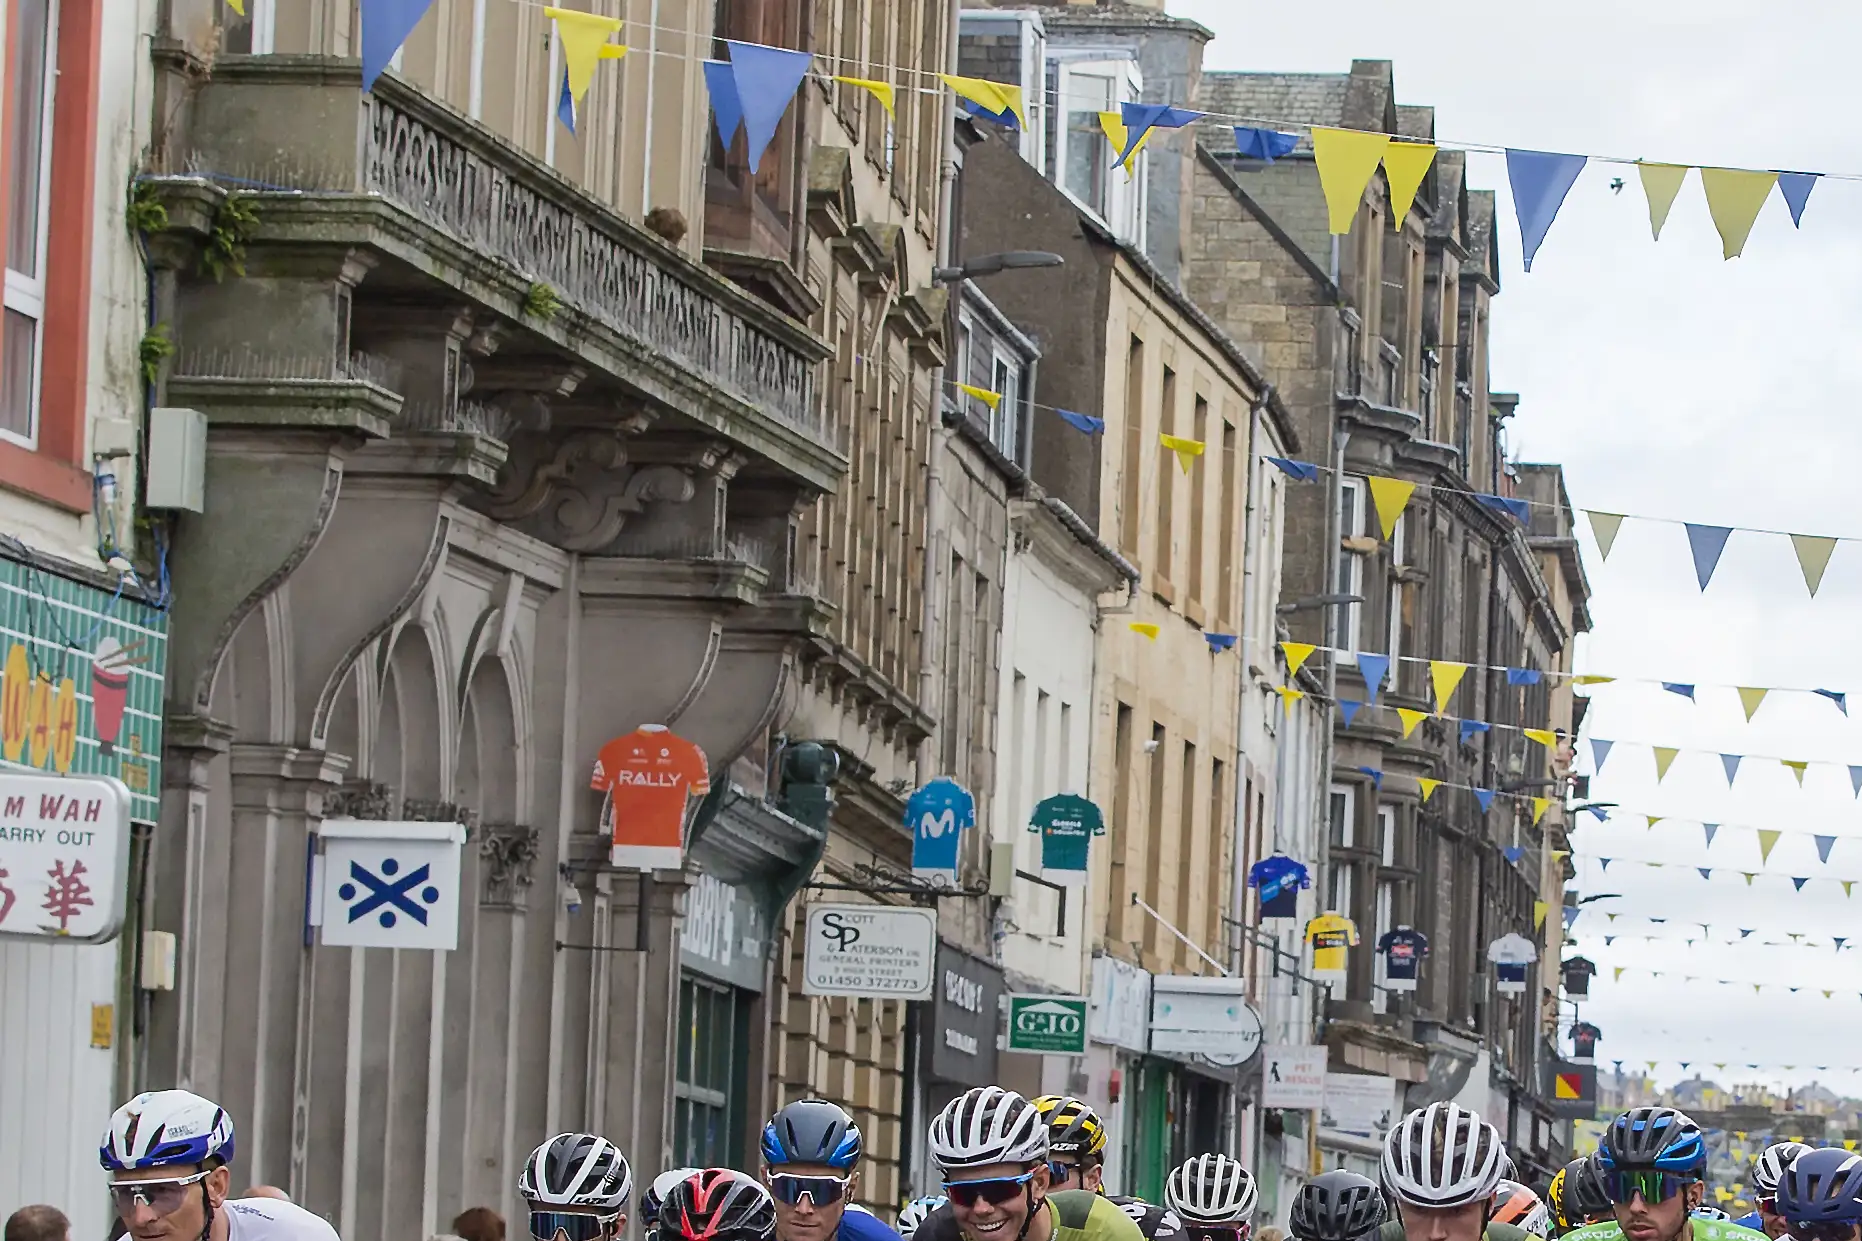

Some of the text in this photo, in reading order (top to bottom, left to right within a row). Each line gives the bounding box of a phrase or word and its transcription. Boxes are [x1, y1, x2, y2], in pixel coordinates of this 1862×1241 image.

[619, 770, 682, 787] RALLY
[40, 794, 102, 822] WAH
[57, 830, 95, 846] OUT
[819, 955, 920, 968] GENERAL PRINTERS
[818, 975, 919, 989] 01450 372773
[1050, 1142, 1080, 1151] AZER
